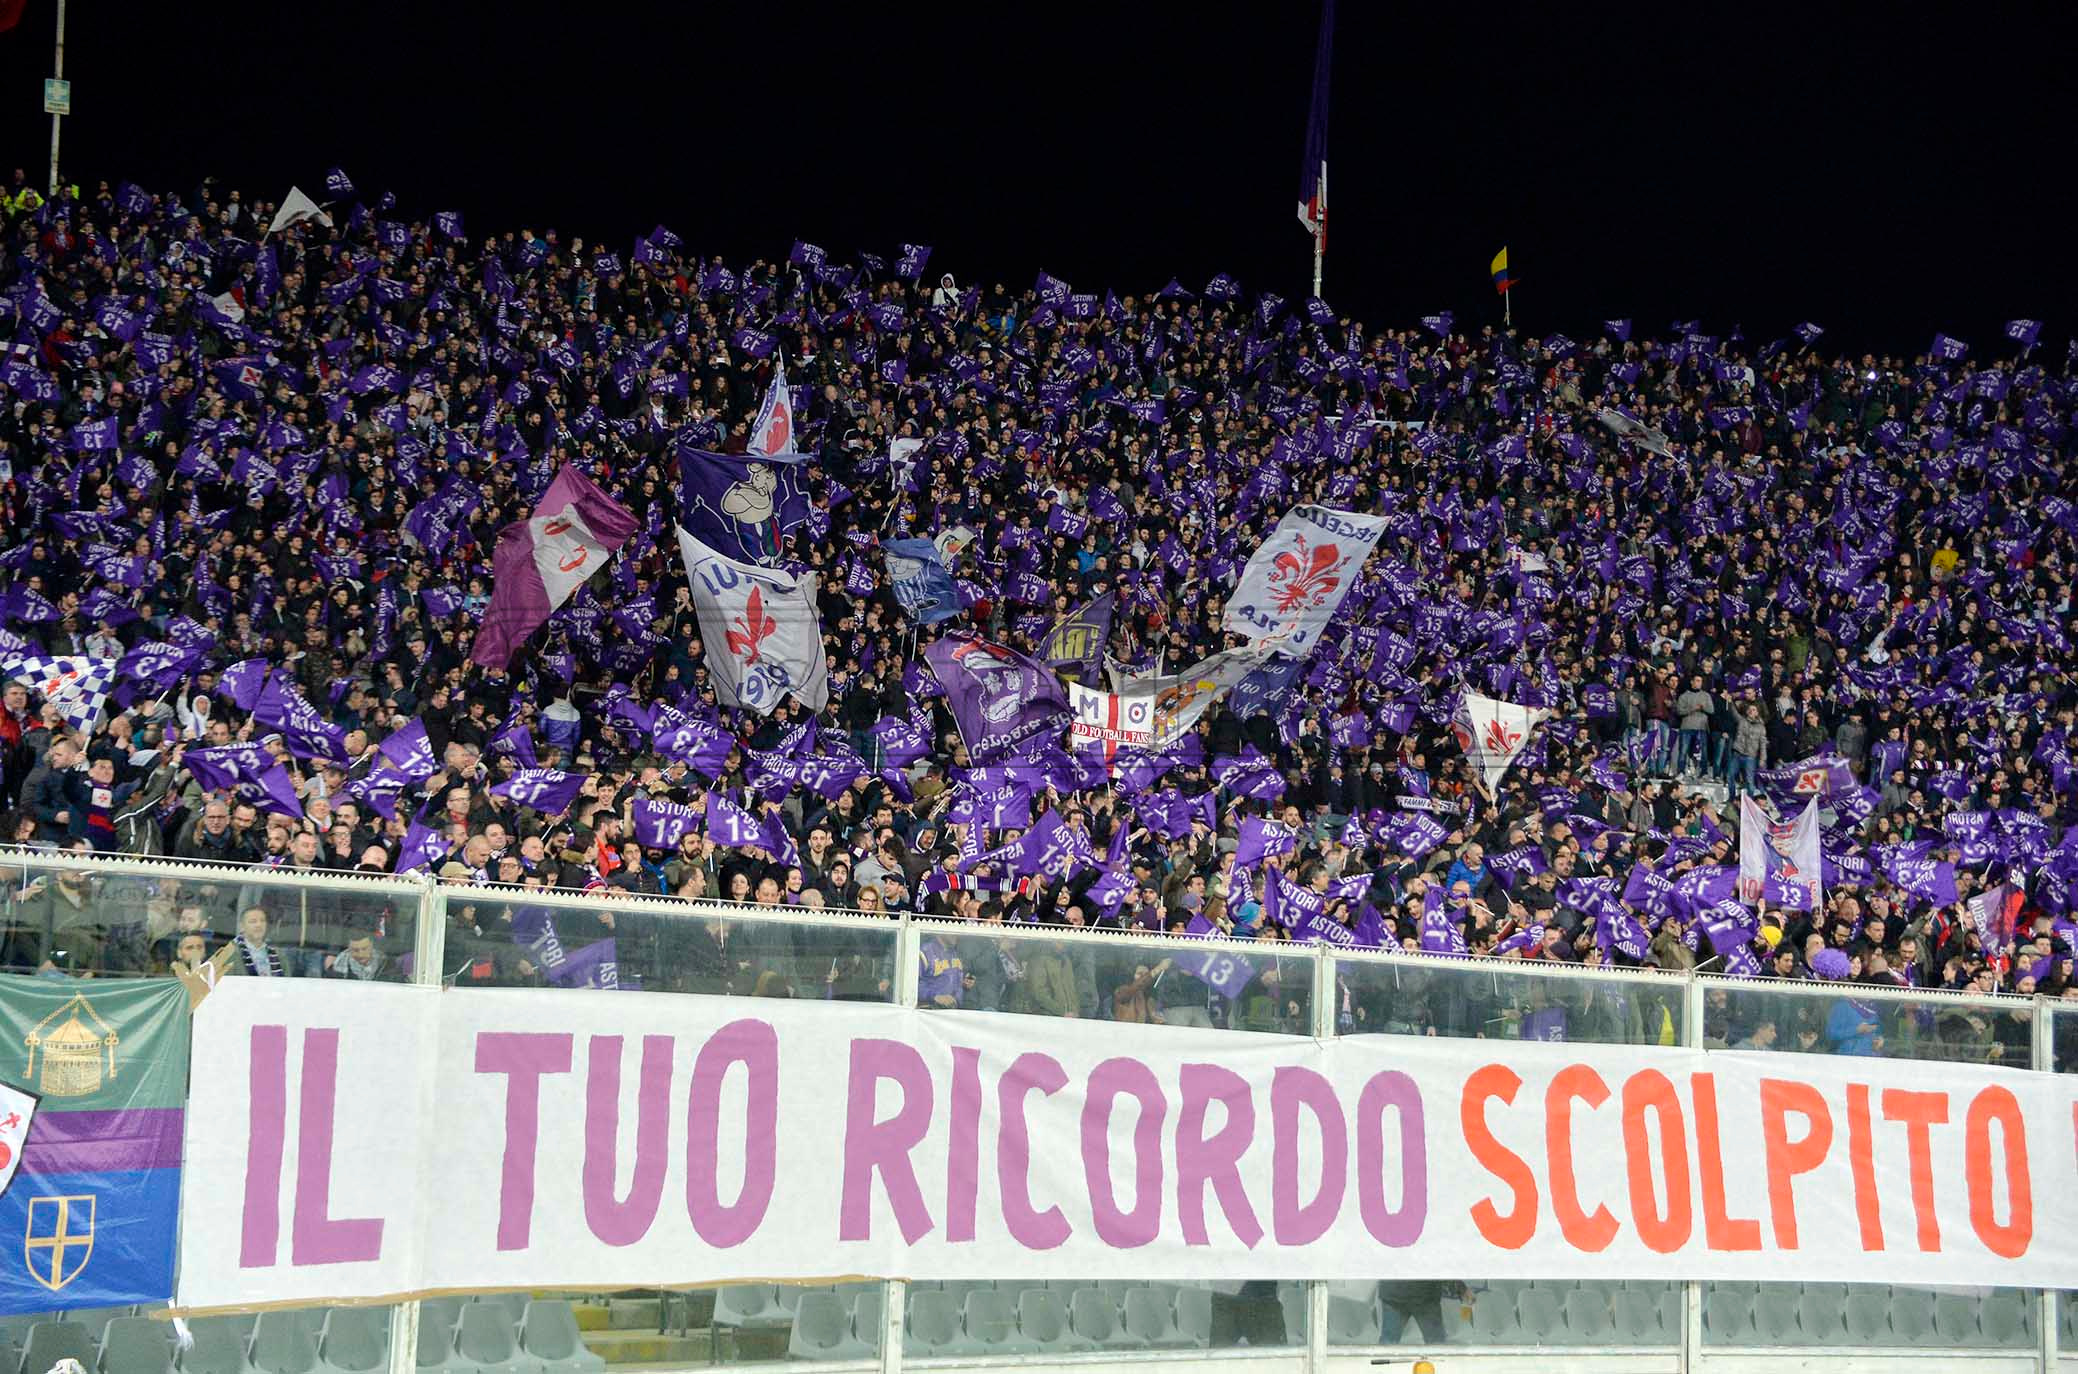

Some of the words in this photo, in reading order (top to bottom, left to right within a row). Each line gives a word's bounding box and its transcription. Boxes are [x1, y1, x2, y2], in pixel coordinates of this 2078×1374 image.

[389, 228, 405, 242] 13
[646, 248, 664, 261] 13
[803, 253, 821, 265] 13
[719, 277, 737, 291] 13
[1071, 294, 1094, 302] ASTORI
[1073, 303, 1088, 315] 13
[33, 309, 50, 328] 13
[150, 349, 169, 364] 13
[1943, 346, 1958, 359] 13
[1724, 365, 1739, 377] 13
[35, 383, 53, 398] 13
[1724, 410, 1741, 425] 13
[282, 429, 301, 444] 13
[1937, 461, 1950, 473] 13
[78, 519, 99, 533] 13
[1062, 519, 1080, 535] 13
[1465, 535, 1481, 549] 13
[1168, 552, 1184, 569] 13
[330, 563, 351, 577] 13
[1018, 571, 1047, 586] ASTORI
[965, 584, 985, 601] 13
[1020, 584, 1039, 601] 13
[1397, 592, 1415, 605] 13
[1533, 586, 1552, 599] 13
[442, 594, 463, 610] 13
[24, 601, 48, 620] 13
[631, 606, 652, 626] 13
[574, 621, 591, 636] 13
[1425, 616, 1442, 632] 13
[1389, 647, 1406, 662] 13
[1381, 672, 1396, 685] 13
[1073, 723, 1090, 735] OLD
[1090, 726, 1131, 742] FOOTBALL
[1132, 731, 1150, 744] FANS
[299, 736, 335, 758] 13
[217, 750, 261, 779] 13
[400, 751, 435, 777] 13
[1514, 755, 1536, 767] 13
[1847, 797, 1872, 820] 13
[652, 818, 684, 845] 13
[725, 817, 760, 841] 13
[1040, 845, 1061, 876] 13
[1279, 878, 1320, 911] ASTORI
[1778, 885, 1801, 907] 13
[1279, 899, 1302, 928] 13
[1307, 915, 1355, 948] ASTORI
[1608, 918, 1633, 940] 13
[1200, 953, 1234, 985] 13
[241, 1025, 384, 1267] IL
[476, 1019, 777, 1250] TUO
[840, 1040, 1426, 1250] RICORDO
[1460, 1063, 2033, 1259] SCOLPITO
